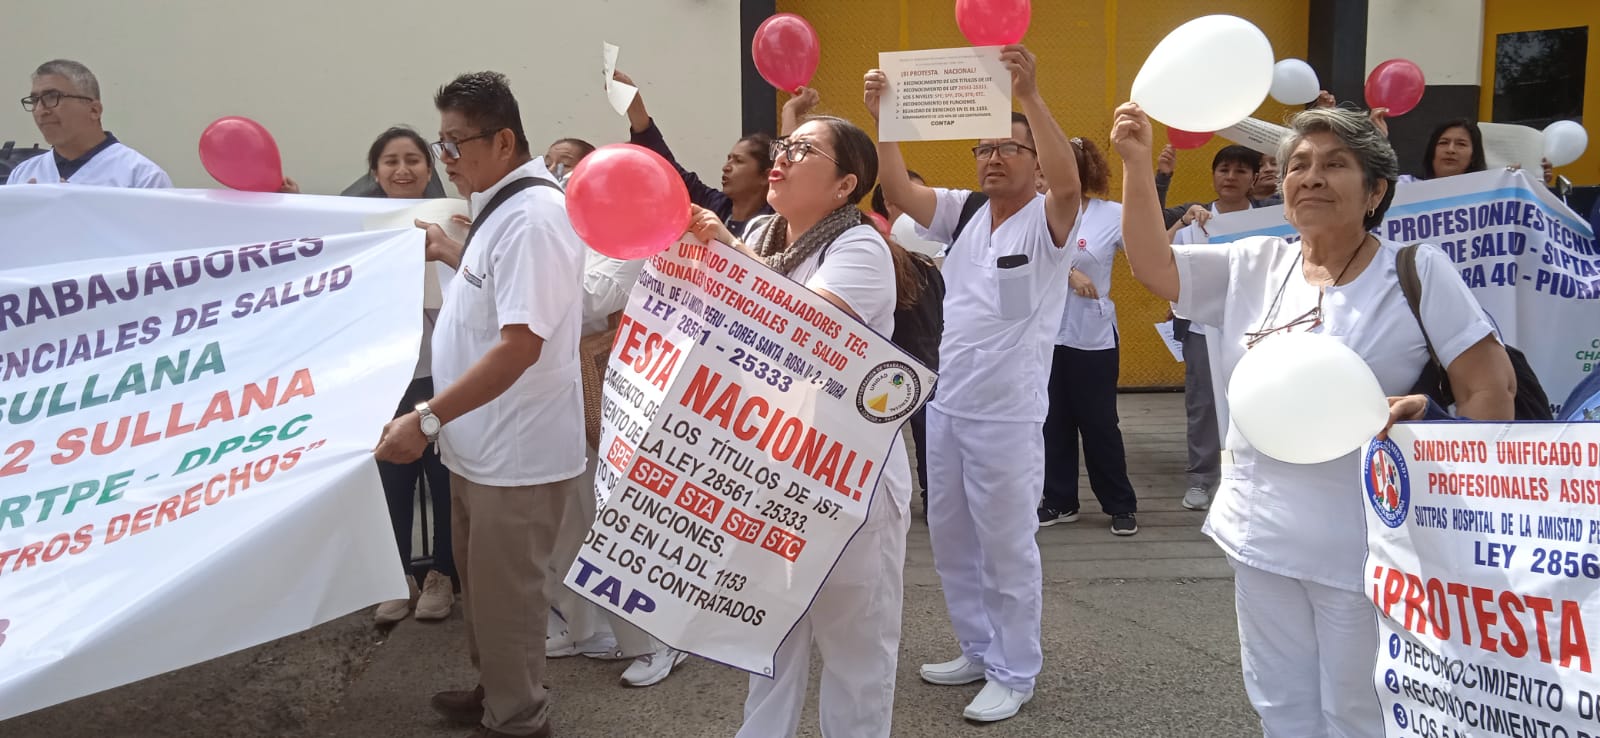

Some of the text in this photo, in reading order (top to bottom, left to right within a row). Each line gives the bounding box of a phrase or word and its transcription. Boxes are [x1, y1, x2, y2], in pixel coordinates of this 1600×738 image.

[1388, 201, 1545, 242] PROFESIONALES
[727, 264, 748, 284] DE
[751, 276, 842, 340] TRABAJADORES
[844, 332, 869, 360] TEC.
[1491, 262, 1518, 287] 40
[0, 265, 353, 381] NCIALES DE SALUD
[642, 295, 676, 321] LEY
[728, 347, 793, 393] 25333
[669, 286, 680, 302] DE
[703, 305, 726, 329] PERU
[728, 320, 755, 347] COREA
[755, 334, 784, 362] SANTA
[783, 352, 806, 376] ROSA
[821, 377, 848, 400] PIURA
[791, 327, 811, 347] DE
[812, 340, 848, 372] SALUD
[0, 341, 226, 425] ULLANA
[50, 368, 316, 466] SULLANA
[172, 414, 313, 477] DPSC
[644, 400, 660, 422] DE
[661, 413, 702, 445] LOS
[707, 437, 780, 490] TÍTULOS
[784, 481, 811, 504] DE
[679, 364, 874, 502] NACIONAL!
[1414, 440, 1488, 464] SINDICATO
[1496, 441, 1582, 467] UNIFICADO
[609, 441, 801, 558] SPE SPF STA STB STC
[625, 420, 643, 445] DE
[638, 432, 664, 458] LA
[665, 446, 705, 477] LEY
[702, 468, 754, 507] 28561
[760, 500, 808, 533] 25333.
[1428, 472, 1549, 501] PROFESIONALES
[620, 486, 725, 558] FUNCIONES.
[630, 523, 660, 550] EN
[658, 538, 684, 565] LA
[685, 553, 708, 579] DL
[714, 569, 747, 592] 1153
[1414, 505, 1447, 530] SUTTPAS
[1452, 508, 1495, 534] HOSPITAL
[1501, 512, 1514, 536] DE
[1519, 514, 1532, 538] LA
[1538, 516, 1583, 542] AMISTAD
[1474, 541, 1600, 580] LEY 2856
[574, 556, 656, 615] TAP
[606, 542, 646, 575] LOS
[647, 565, 766, 626] CONTRATADOS
[1374, 565, 1593, 673] ¡PROTESTA
[1404, 641, 1564, 713] RECONOCIMIENTO
